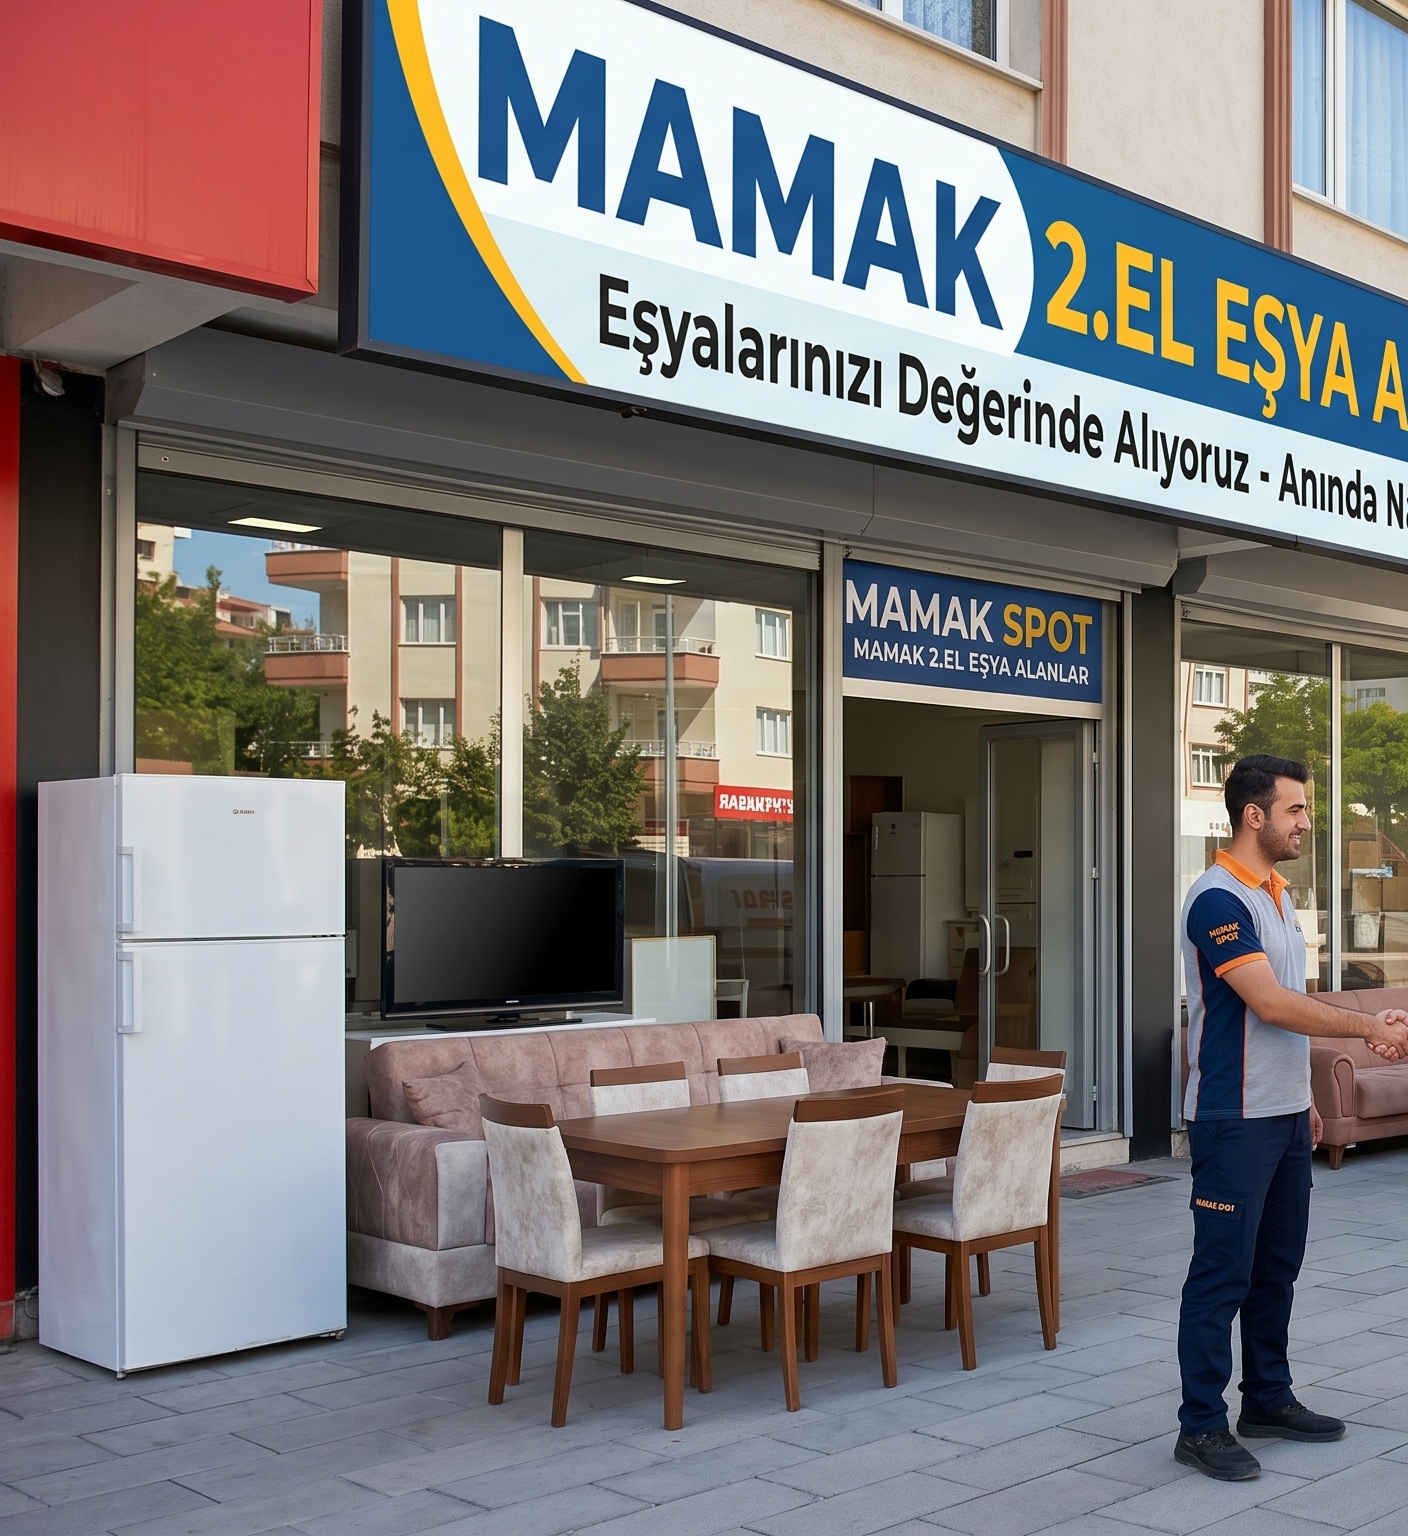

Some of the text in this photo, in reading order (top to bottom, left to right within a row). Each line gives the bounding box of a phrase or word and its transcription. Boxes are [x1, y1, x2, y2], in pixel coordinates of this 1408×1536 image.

[477, 15, 1004, 331] MAMAK
[599, 273, 882, 410] Eşyalarınızı
[898, 352, 1104, 459] Değerinde
[1113, 409, 1250, 494] Alıyoruz
[1278, 452, 1377, 524] Anında
[1046, 220, 1195, 366] 2.EL
[1217, 278, 1359, 418] EŞYA
[845, 579, 1093, 655] MAMAK SPOT
[853, 637, 1089, 686] MAMAK 2.EL EŞYA ALANLAR
